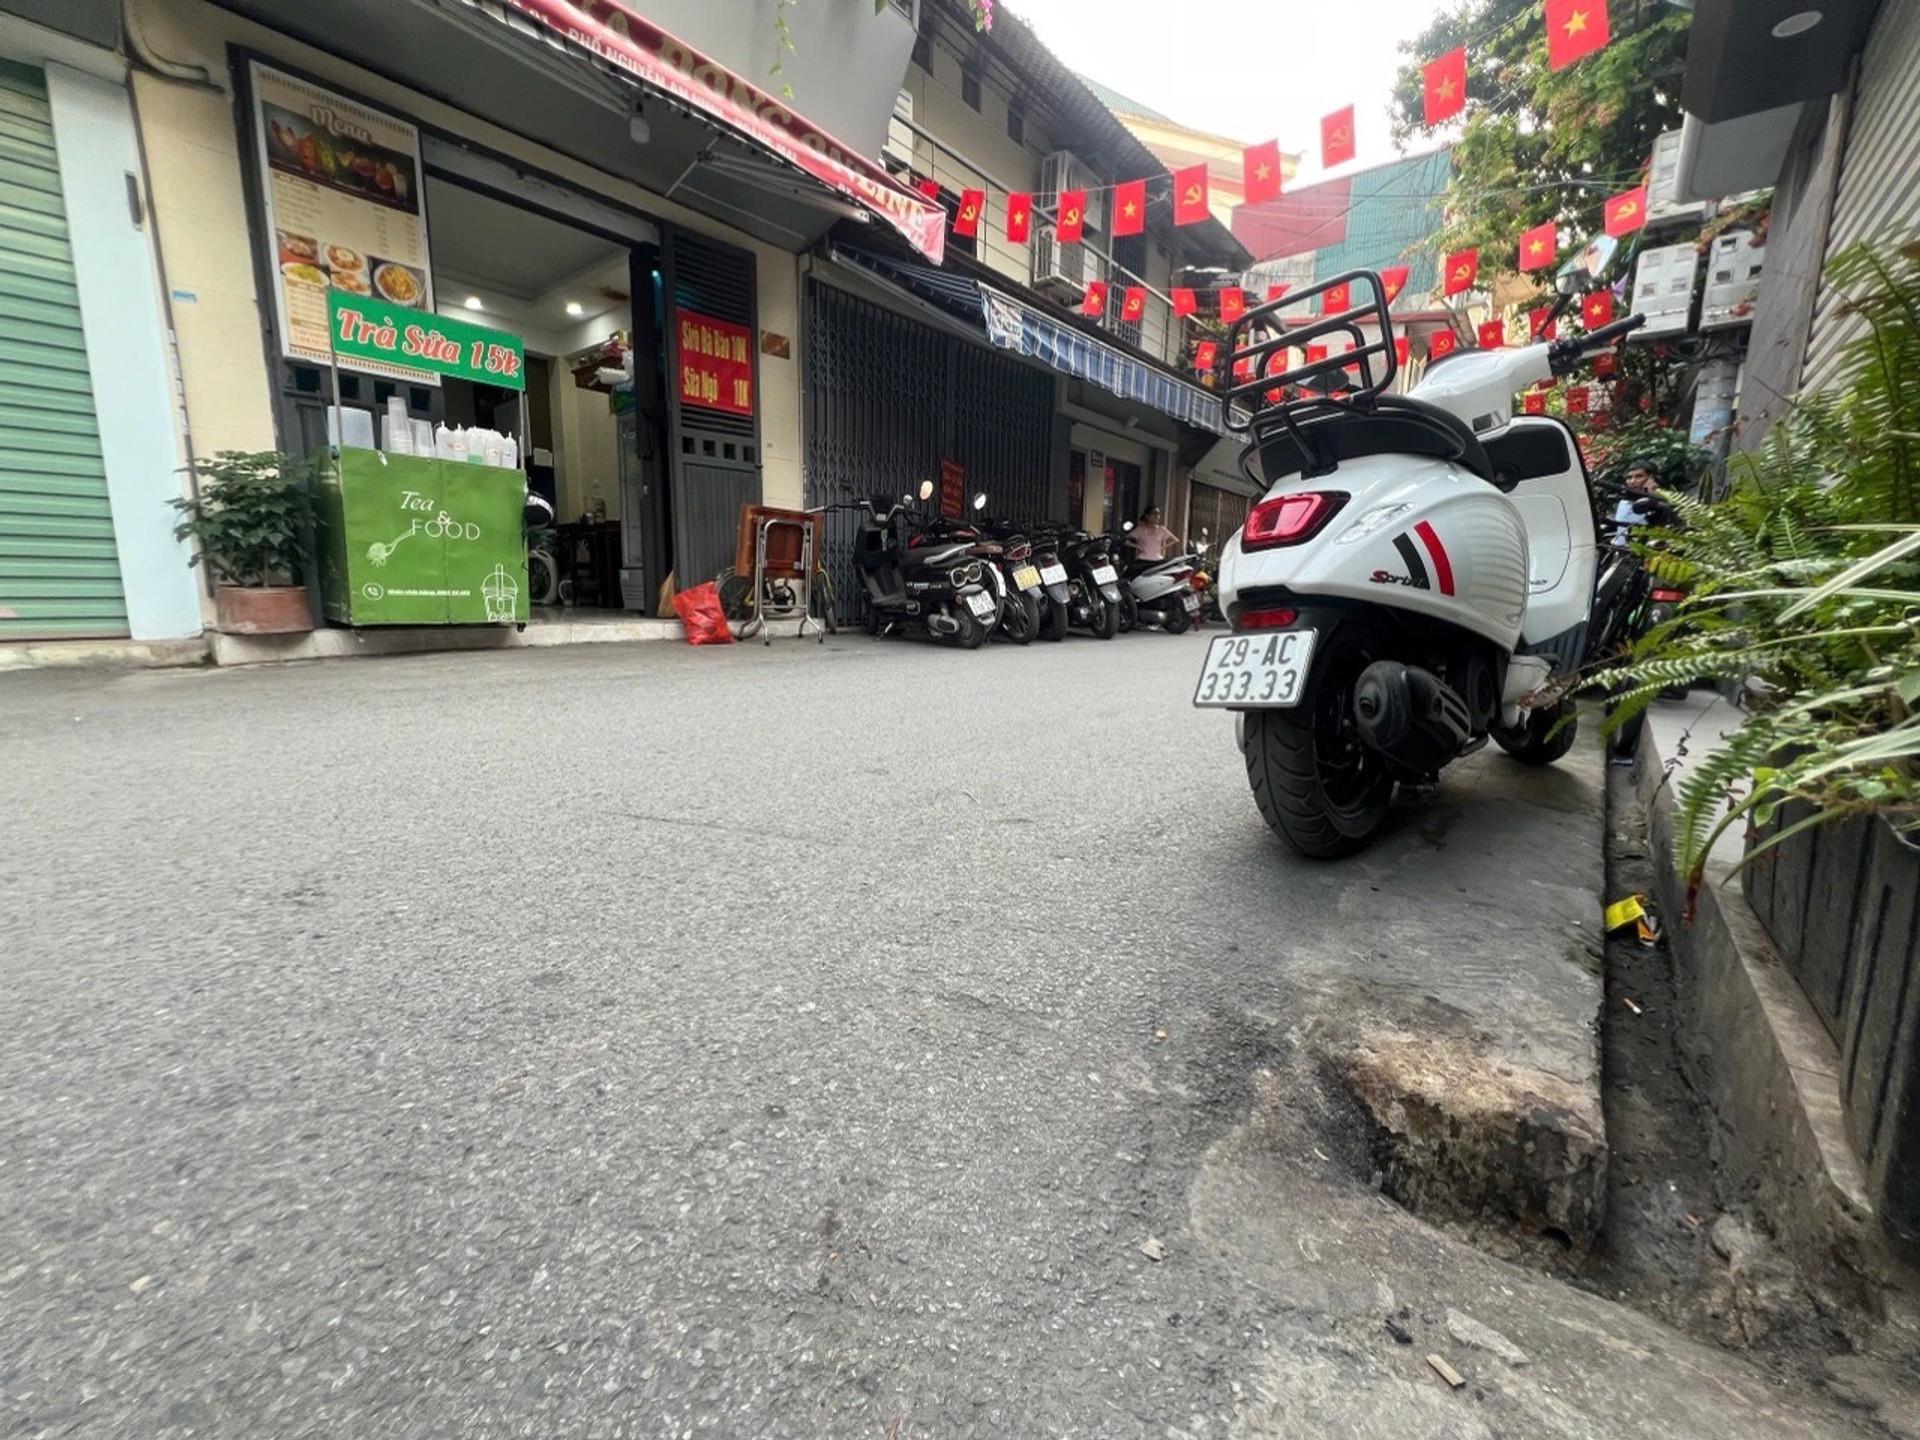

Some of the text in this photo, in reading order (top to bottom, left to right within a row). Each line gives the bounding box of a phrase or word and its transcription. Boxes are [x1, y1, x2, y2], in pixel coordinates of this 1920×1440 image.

[309, 104, 372, 145] Menu
[337, 307, 397, 350] Trà
[402, 324, 462, 364] Sữa
[401, 491, 434, 511] Tea
[412, 518, 480, 540] FOOD
[438, 510, 451, 525] &
[1218, 635, 1297, 668] 29-AC
[1201, 670, 1297, 701] 333.33
